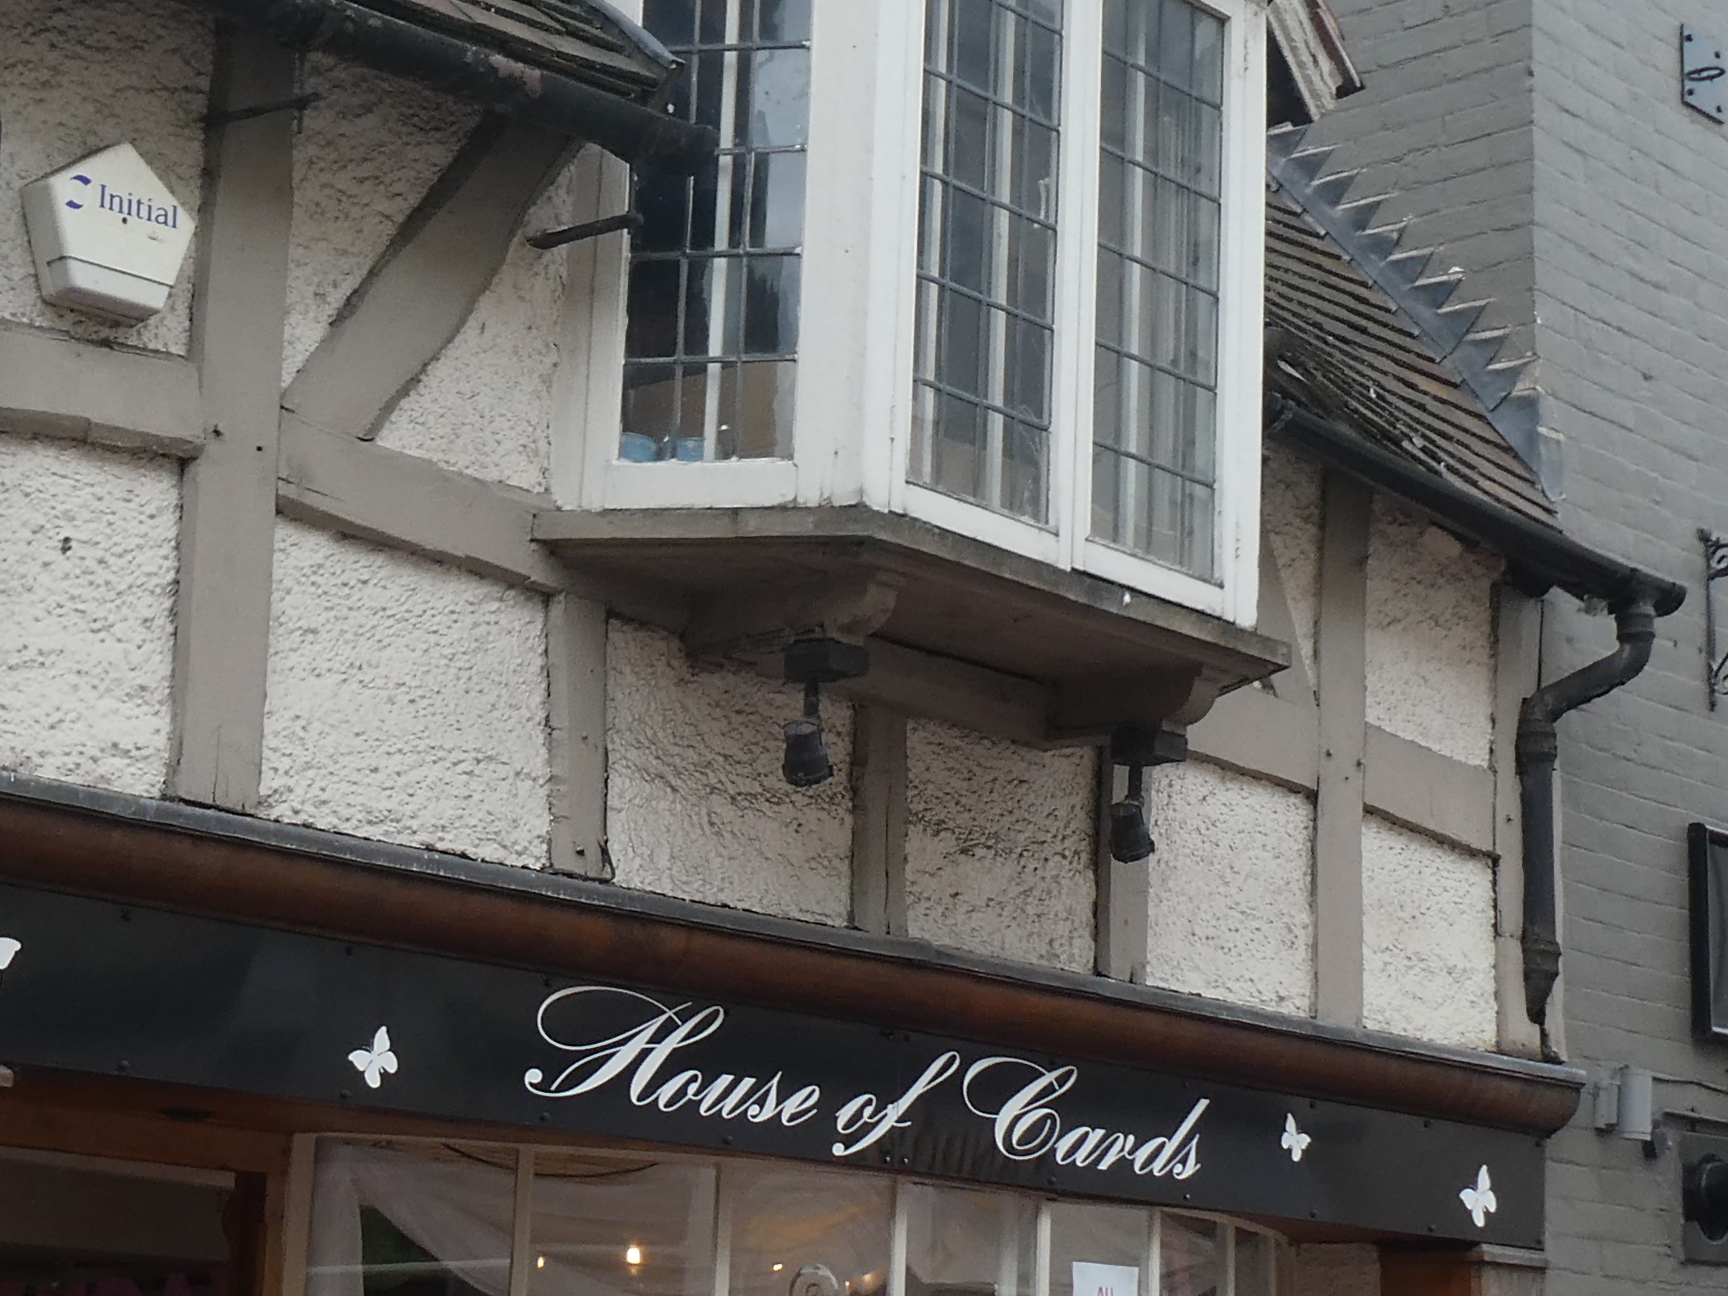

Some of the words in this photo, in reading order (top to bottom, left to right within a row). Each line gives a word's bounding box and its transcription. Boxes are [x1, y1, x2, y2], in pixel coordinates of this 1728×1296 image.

[99, 184, 178, 229] Initial
[524, 985, 821, 1127] House
[831, 1050, 961, 1157] of
[962, 1056, 1211, 1181] Cards
